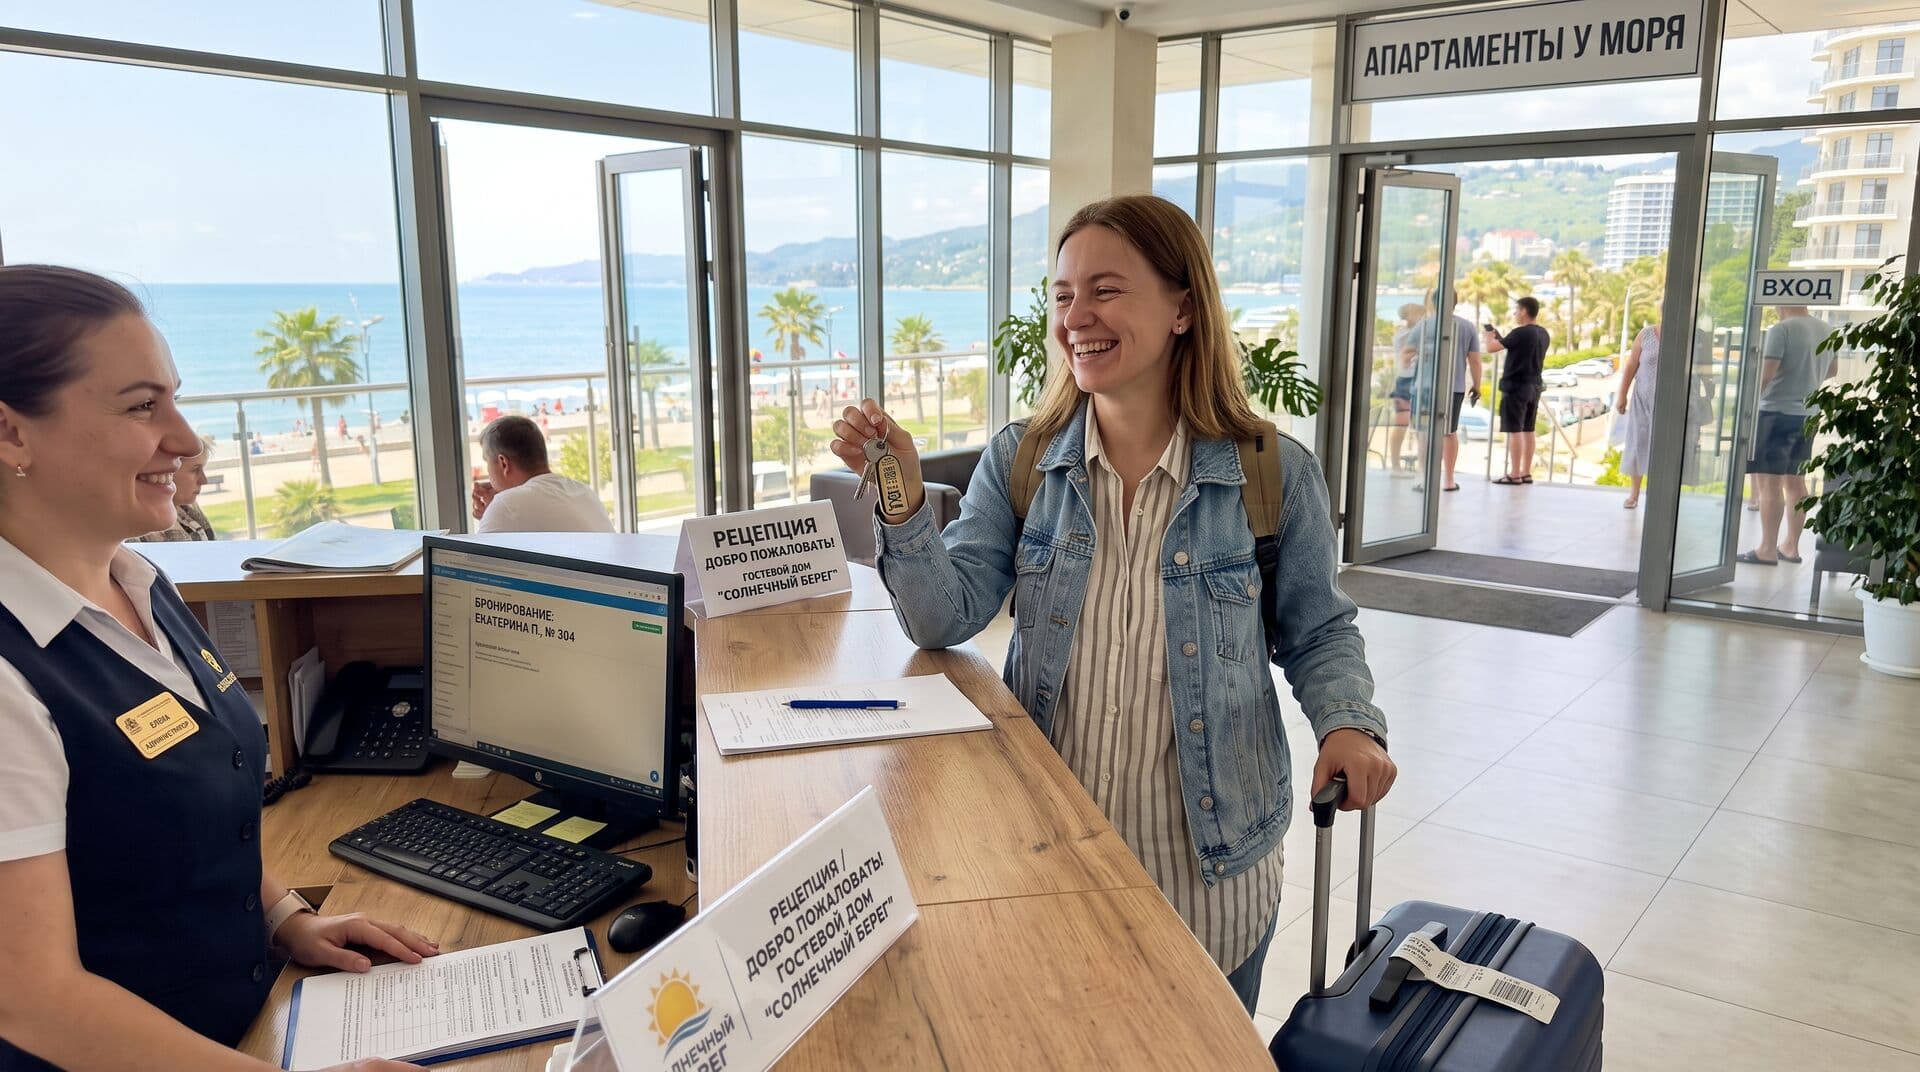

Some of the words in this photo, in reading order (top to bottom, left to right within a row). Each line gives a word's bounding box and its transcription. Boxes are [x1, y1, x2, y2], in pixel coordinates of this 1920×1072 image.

[1363, 26, 1564, 77] АПАРТАМЕНТЫ
[1573, 24, 1593, 59] У
[1599, 14, 1686, 56] МОРЯ
[1762, 278, 1832, 300] ВХОД
[713, 517, 817, 548] РЕЦЕПЦИЯ
[705, 552, 748, 571] ДОБРО
[751, 537, 835, 562] ПОЖАЛОВАТЬ!
[718, 575, 799, 601] "СОЛНЕЧНЫЙ
[801, 569, 839, 586] БЕРЕГ"
[742, 564, 790, 582] ГОСТЕВОЙ
[791, 562, 812, 574] ДОМ
[475, 597, 554, 622] БРОНИРОВАНИЕ:
[475, 613, 530, 633] ЕКАТЕРИНА
[545, 626, 555, 638] №
[557, 629, 576, 642] 304
[769, 858, 840, 925] РЕЦЕПЦИЯ
[746, 926, 795, 982] ДОБРО
[795, 851, 884, 935] ПОЖАЛОВАТЬ!
[776, 910, 845, 983] ГОСТЕВОЙ
[846, 888, 874, 925] ДОМ
[765, 930, 856, 1018] "СОЛНЕЧНЫЙ
[855, 895, 894, 942] БЕРЕГ"
[666, 1013, 735, 1072] ЛНЕЧНЫЙ
